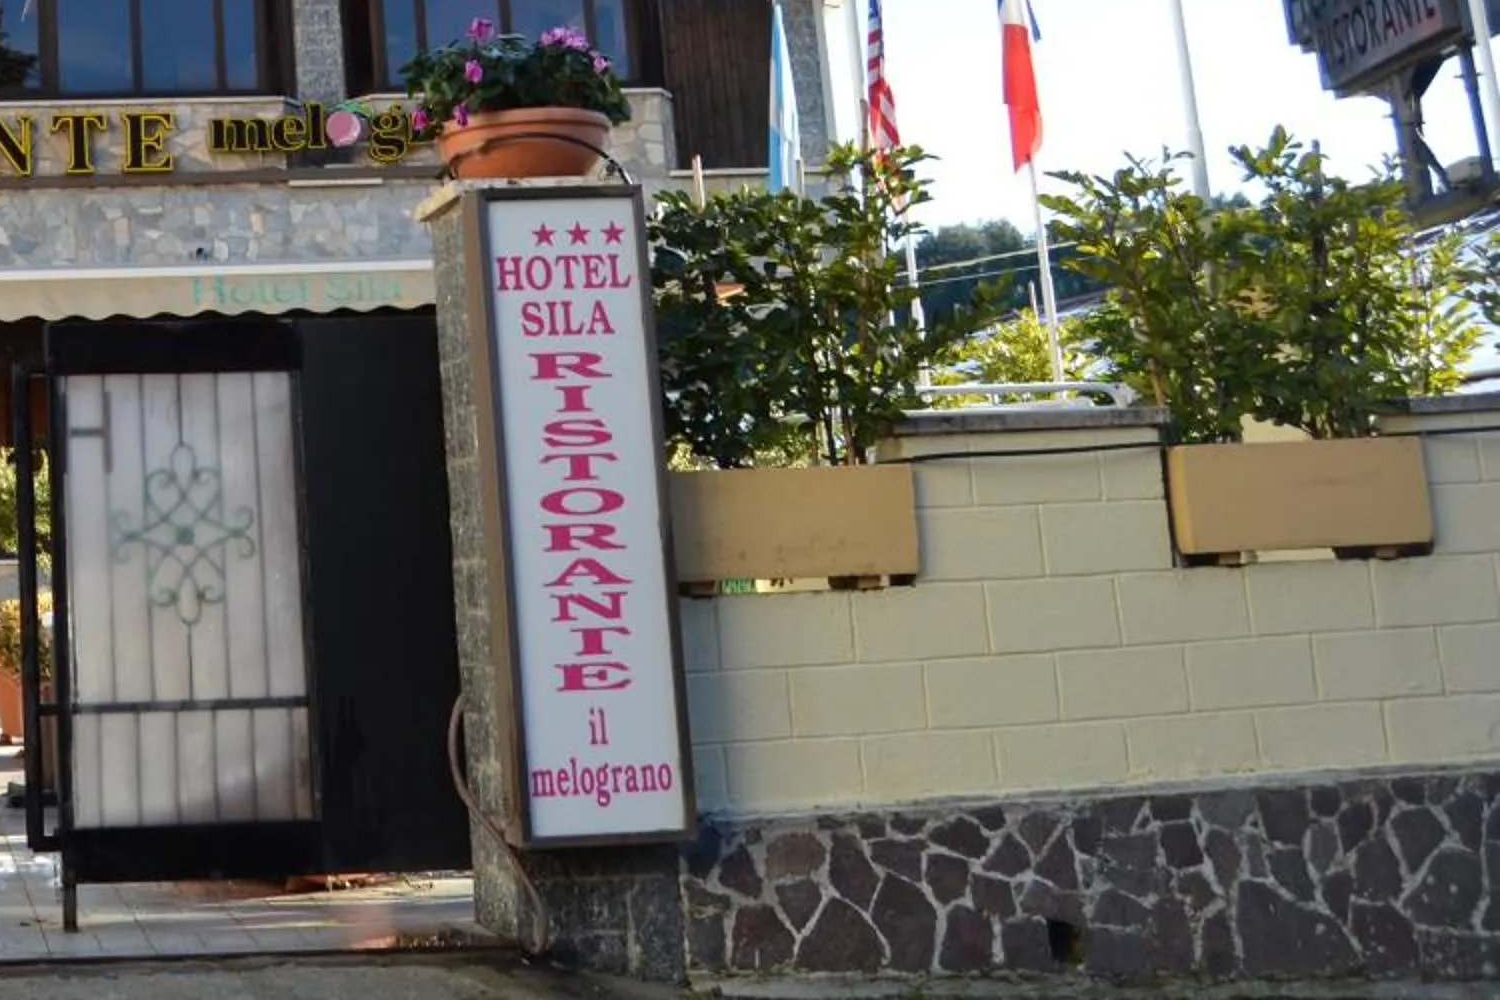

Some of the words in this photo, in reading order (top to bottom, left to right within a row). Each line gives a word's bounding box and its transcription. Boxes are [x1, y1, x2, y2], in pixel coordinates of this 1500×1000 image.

[208, 102, 428, 165] melog
[496, 254, 632, 292] HOTEL
[521, 300, 615, 337] SILA
[529, 351, 633, 693] RISTORANTE
[588, 705, 609, 746] il
[531, 757, 673, 807] melograno
